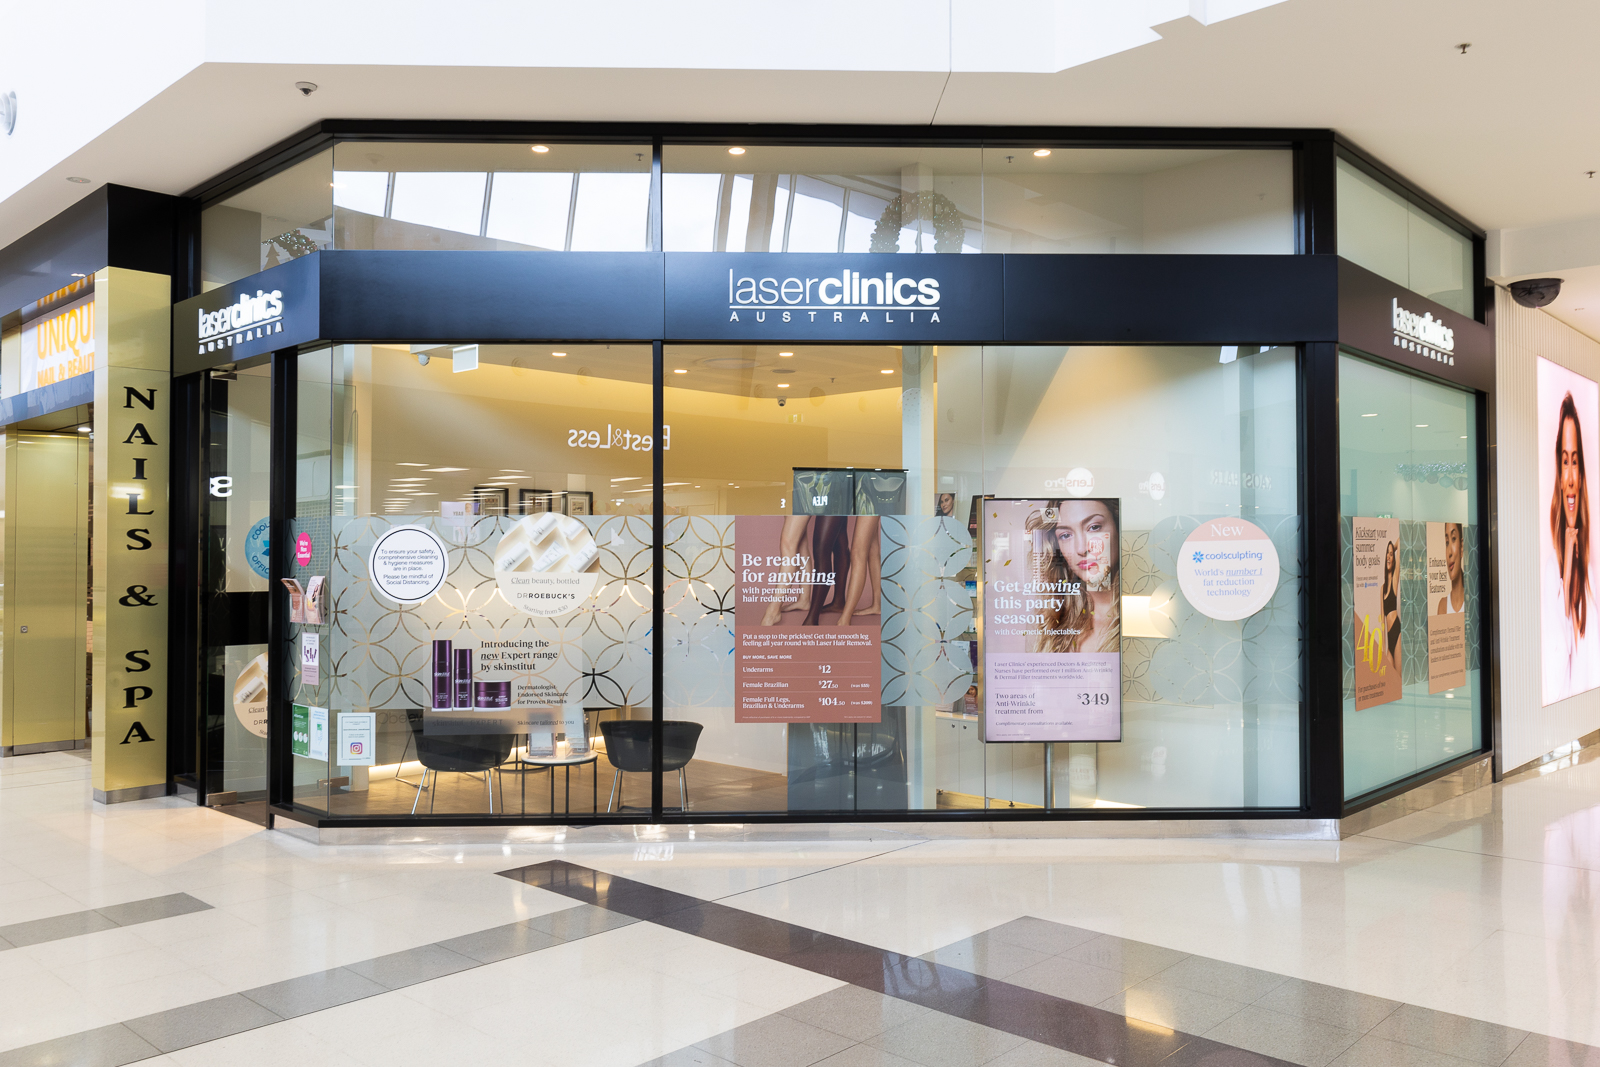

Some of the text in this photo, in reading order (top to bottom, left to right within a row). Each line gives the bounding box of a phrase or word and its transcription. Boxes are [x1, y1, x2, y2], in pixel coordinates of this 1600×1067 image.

[729, 268, 940, 305] laserclinics
[199, 290, 282, 338] laserclinics
[729, 311, 941, 323] AUSTRALIA
[37, 300, 95, 360] UNIQU
[198, 322, 283, 354] AUSTRALIA
[1393, 335, 1454, 366] AUSTRALIA
[37, 363, 66, 388] NAIL &
[1210, 524, 1244, 537] New
[1355, 527, 1387, 541] Kickstart your
[1355, 543, 1375, 552] summer
[742, 553, 810, 569] Be ready
[1205, 551, 1263, 561] coolsculpting
[1355, 554, 1380, 569] body goals
[1428, 557, 1446, 567] Enhance
[119, 386, 158, 745] NAILS & SPA
[742, 569, 836, 586] for anything
[1194, 568, 1257, 576] World's number
[1429, 570, 1447, 583] your best
[531, 577, 556, 585] beauty,
[556, 577, 580, 585] bottled
[993, 579, 1081, 595] Get glowing
[1203, 578, 1255, 586] fat reduction
[742, 586, 804, 595] with permanent
[1207, 588, 1251, 597] technology
[1429, 582, 1446, 593] features
[522, 604, 544, 616] Starting
[994, 596, 1064, 612] this party
[994, 613, 1045, 624] season
[789, 633, 813, 641] prickles!
[860, 633, 869, 641] leg
[1044, 628, 1081, 636] Injectables
[480, 639, 550, 650] Introducing the
[501, 651, 531, 661] Expert
[532, 652, 558, 661] range
[480, 662, 536, 672] by skinstitut
[818, 665, 831, 673] $12
[1076, 692, 1110, 706] $349
